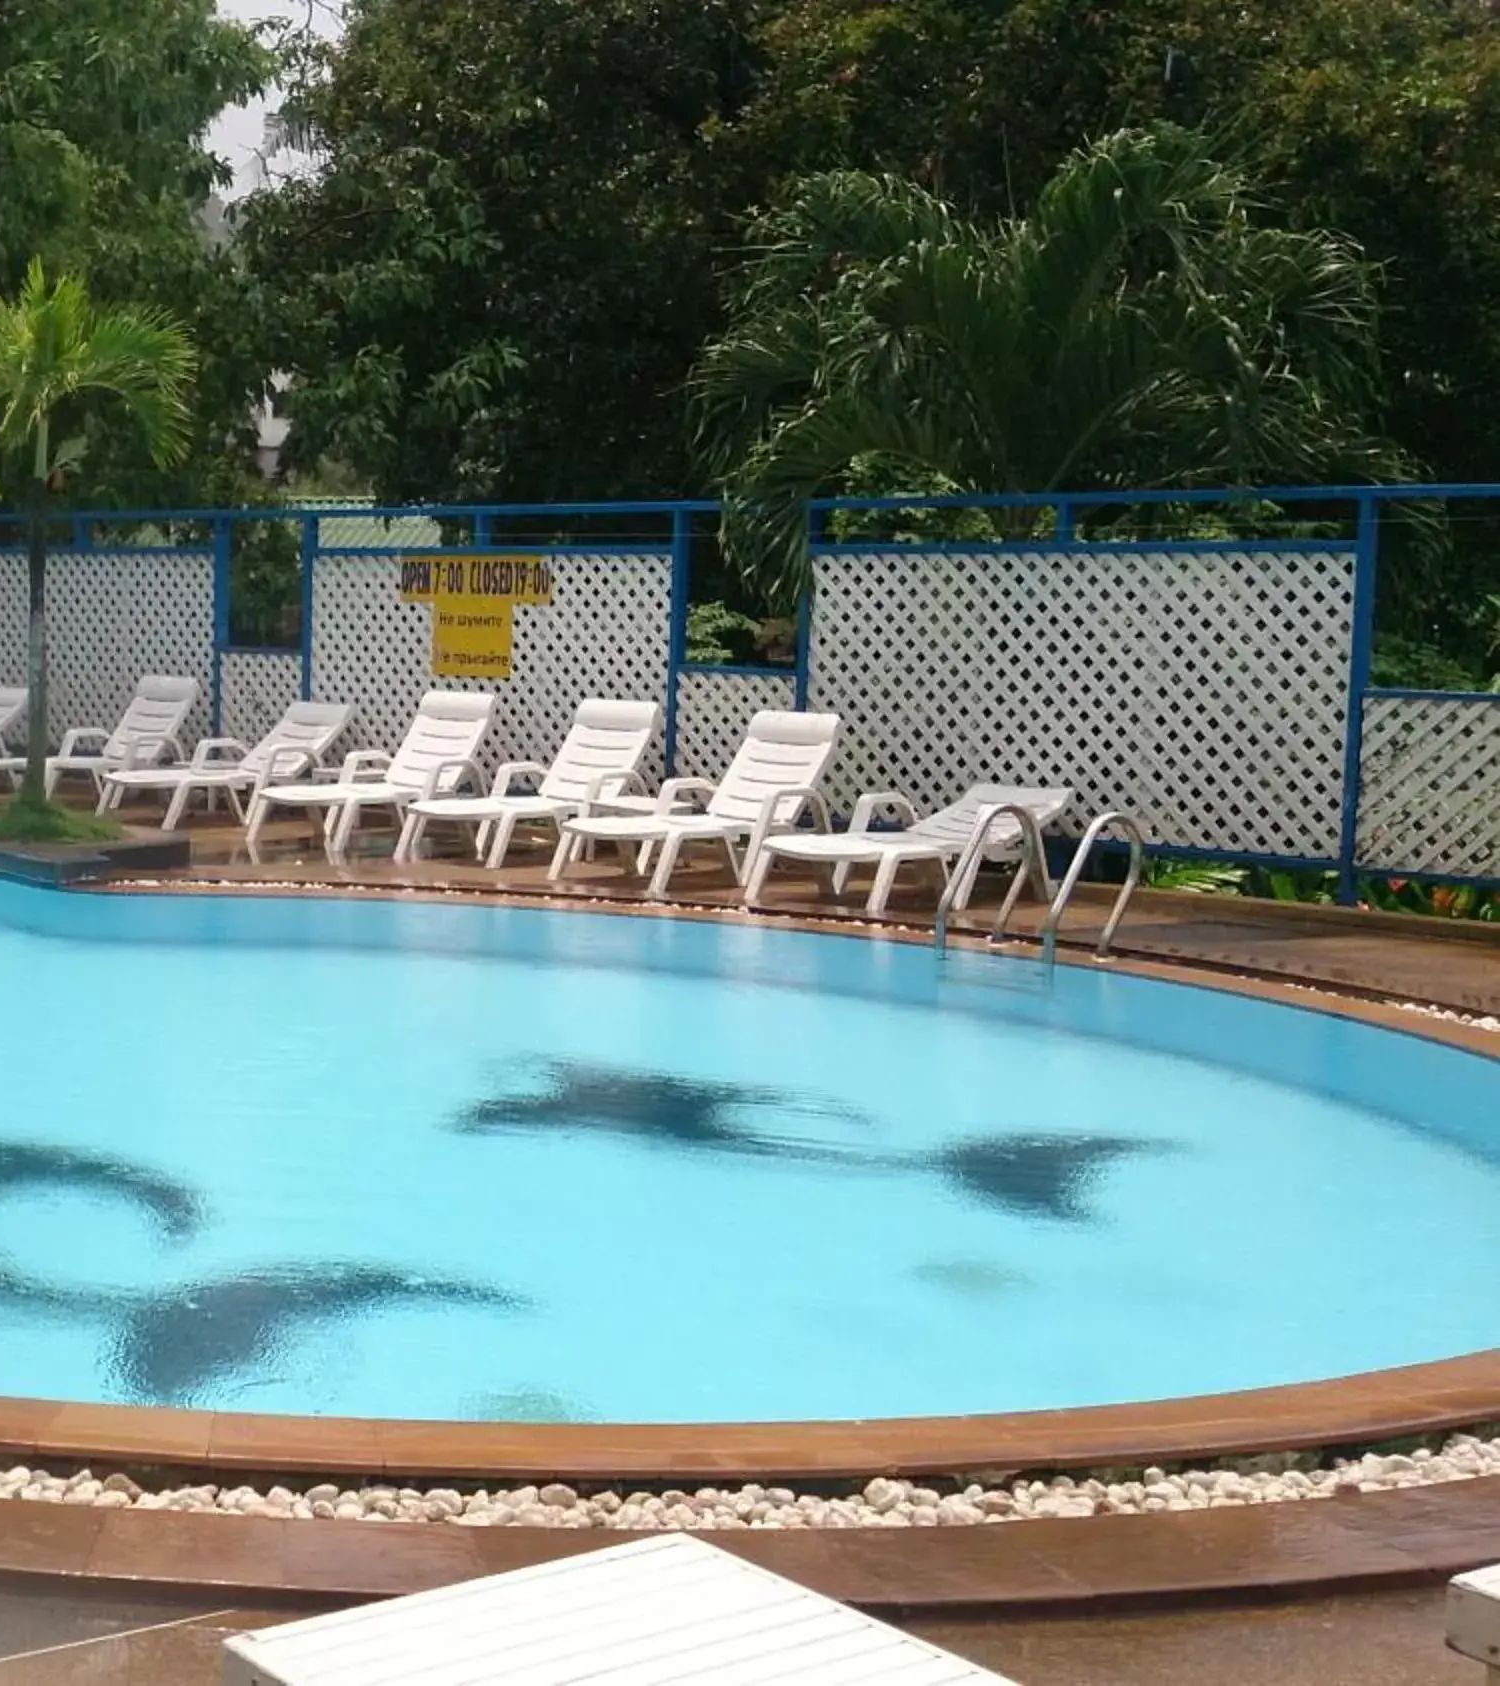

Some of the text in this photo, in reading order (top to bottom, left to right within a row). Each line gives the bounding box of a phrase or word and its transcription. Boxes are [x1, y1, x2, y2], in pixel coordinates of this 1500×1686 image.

[401, 561, 550, 596] OPEN 7:00 CLOSED 19:00
